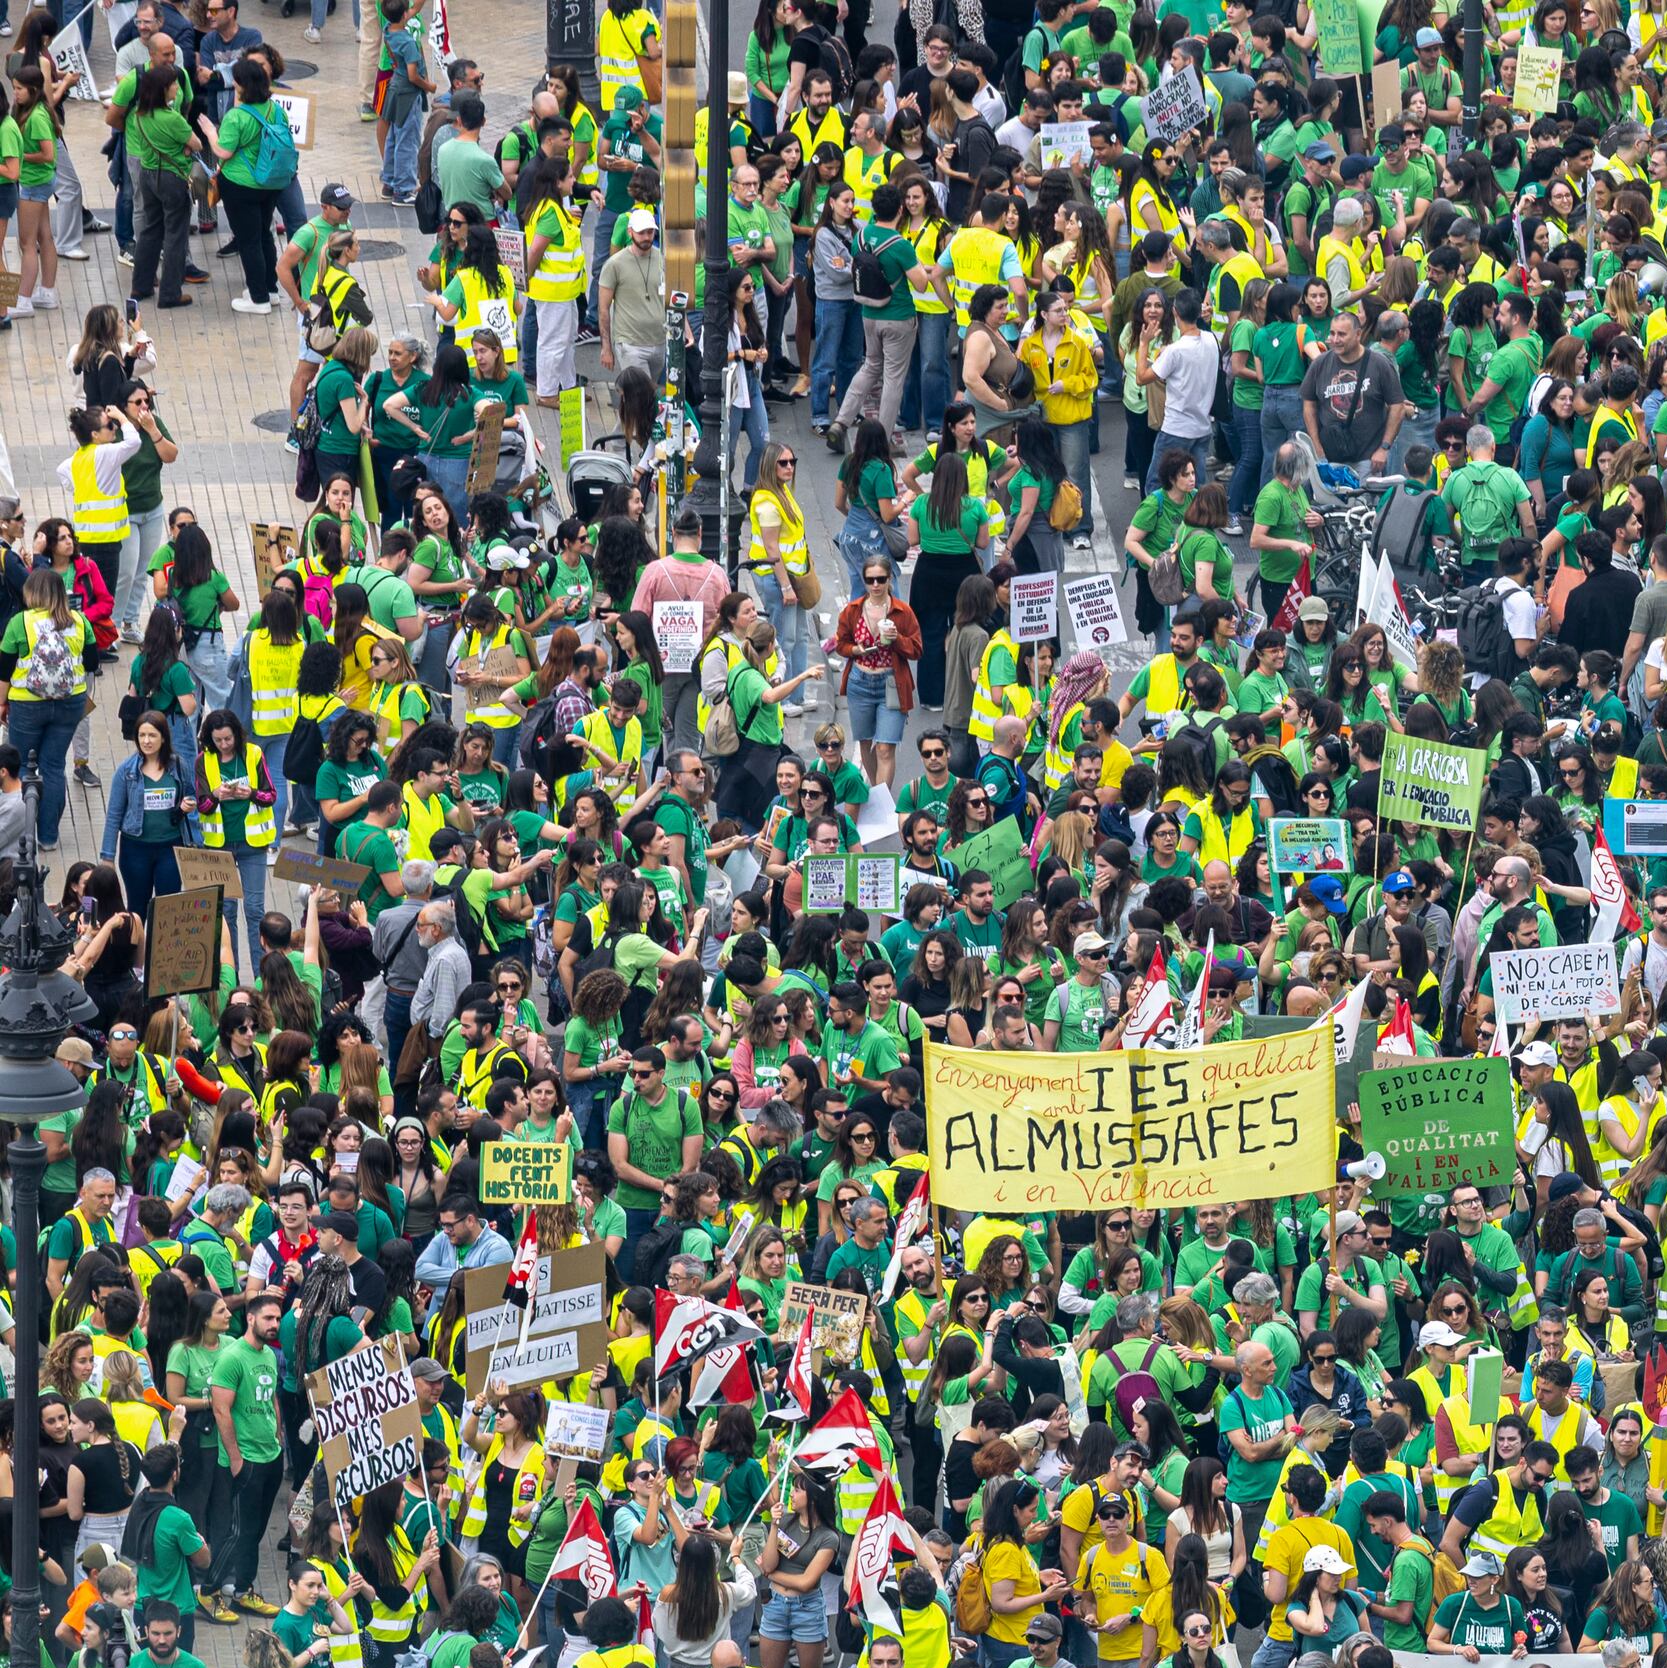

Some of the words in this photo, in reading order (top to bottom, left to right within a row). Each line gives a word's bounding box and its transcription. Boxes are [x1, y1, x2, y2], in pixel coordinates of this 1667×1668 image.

[1507, 959, 1539, 981] NO
[1549, 954, 1609, 975] CABEM
[1528, 981, 1544, 991] EN
[1551, 979, 1566, 990] LA
[1576, 977, 1604, 989] FOTO
[1521, 998, 1539, 1010] DE
[1551, 996, 1592, 1007] CLASSE
[936, 1058, 1089, 1108] Ensenyament
[1086, 1061, 1189, 1113] IES
[1202, 1042, 1321, 1090] qualitat
[1378, 1067, 1489, 1096] EDUCACIÓ
[1043, 1097, 1086, 1118] amb
[1381, 1090, 1485, 1116] PÚBLICA
[945, 1090, 1299, 1178] ALMUSSAFES
[1423, 1119, 1450, 1136] DE
[492, 1148, 562, 1164] DOCENTS
[1386, 1132, 1500, 1157] QUALITAT
[510, 1166, 553, 1182] FENT
[1387, 1161, 1500, 1189] VALENCIÀ
[1415, 1158, 1422, 1170] I
[1435, 1155, 1459, 1170] EN
[485, 1179, 558, 1199] HISTÒRIA
[996, 1179, 1007, 1203] i
[1026, 1182, 1058, 1204] en
[1079, 1171, 1218, 1206] Valencià
[328, 1347, 384, 1398] MENYS
[347, 1417, 382, 1457] MÉS
[335, 1437, 416, 1505] RECURSOS
